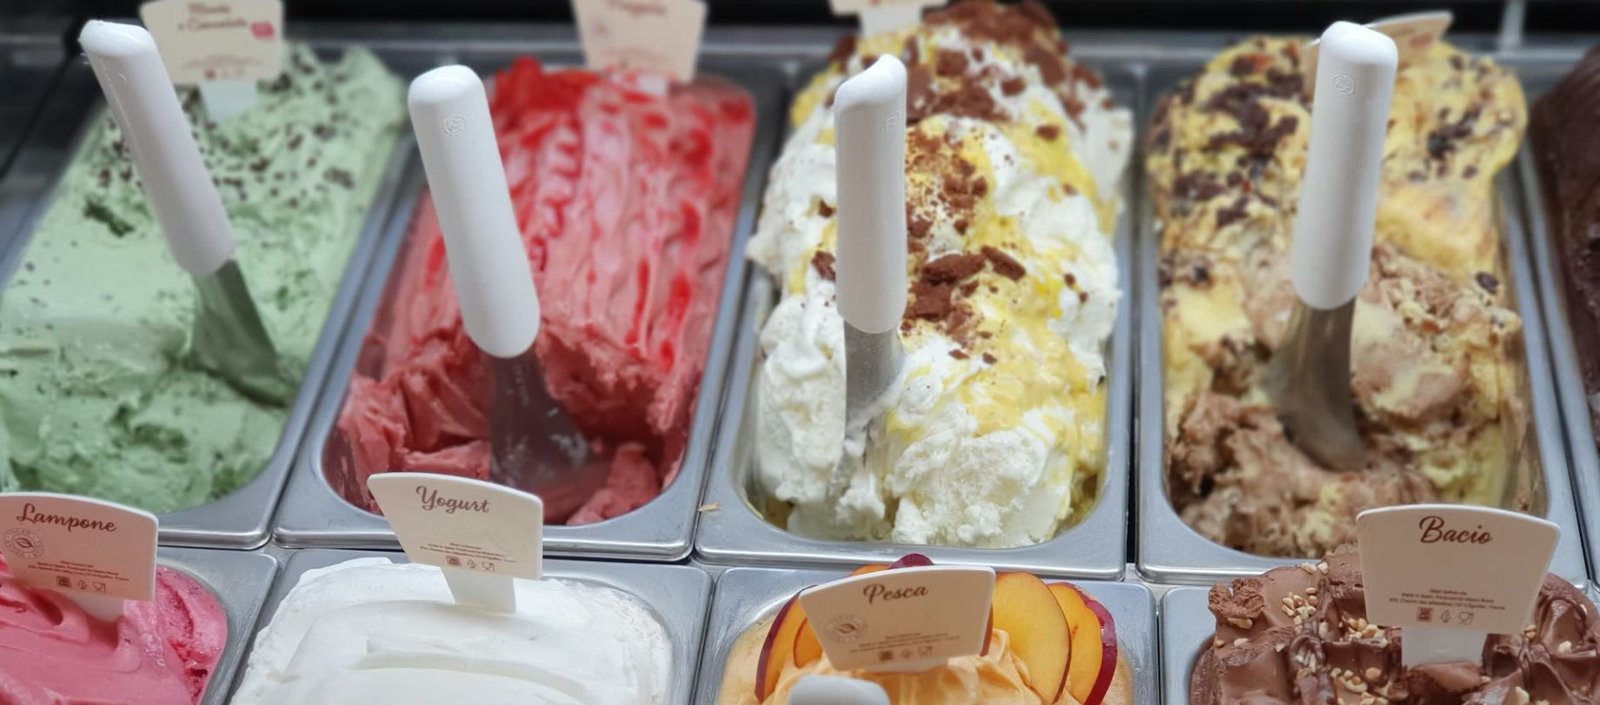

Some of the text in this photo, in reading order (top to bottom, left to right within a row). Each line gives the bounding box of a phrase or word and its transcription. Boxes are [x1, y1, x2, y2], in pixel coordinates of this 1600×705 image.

[415, 485, 491, 514] Yogurt
[16, 502, 117, 532] Lampone
[1418, 515, 1494, 545] Bacio
[862, 583, 929, 606] Pesca
